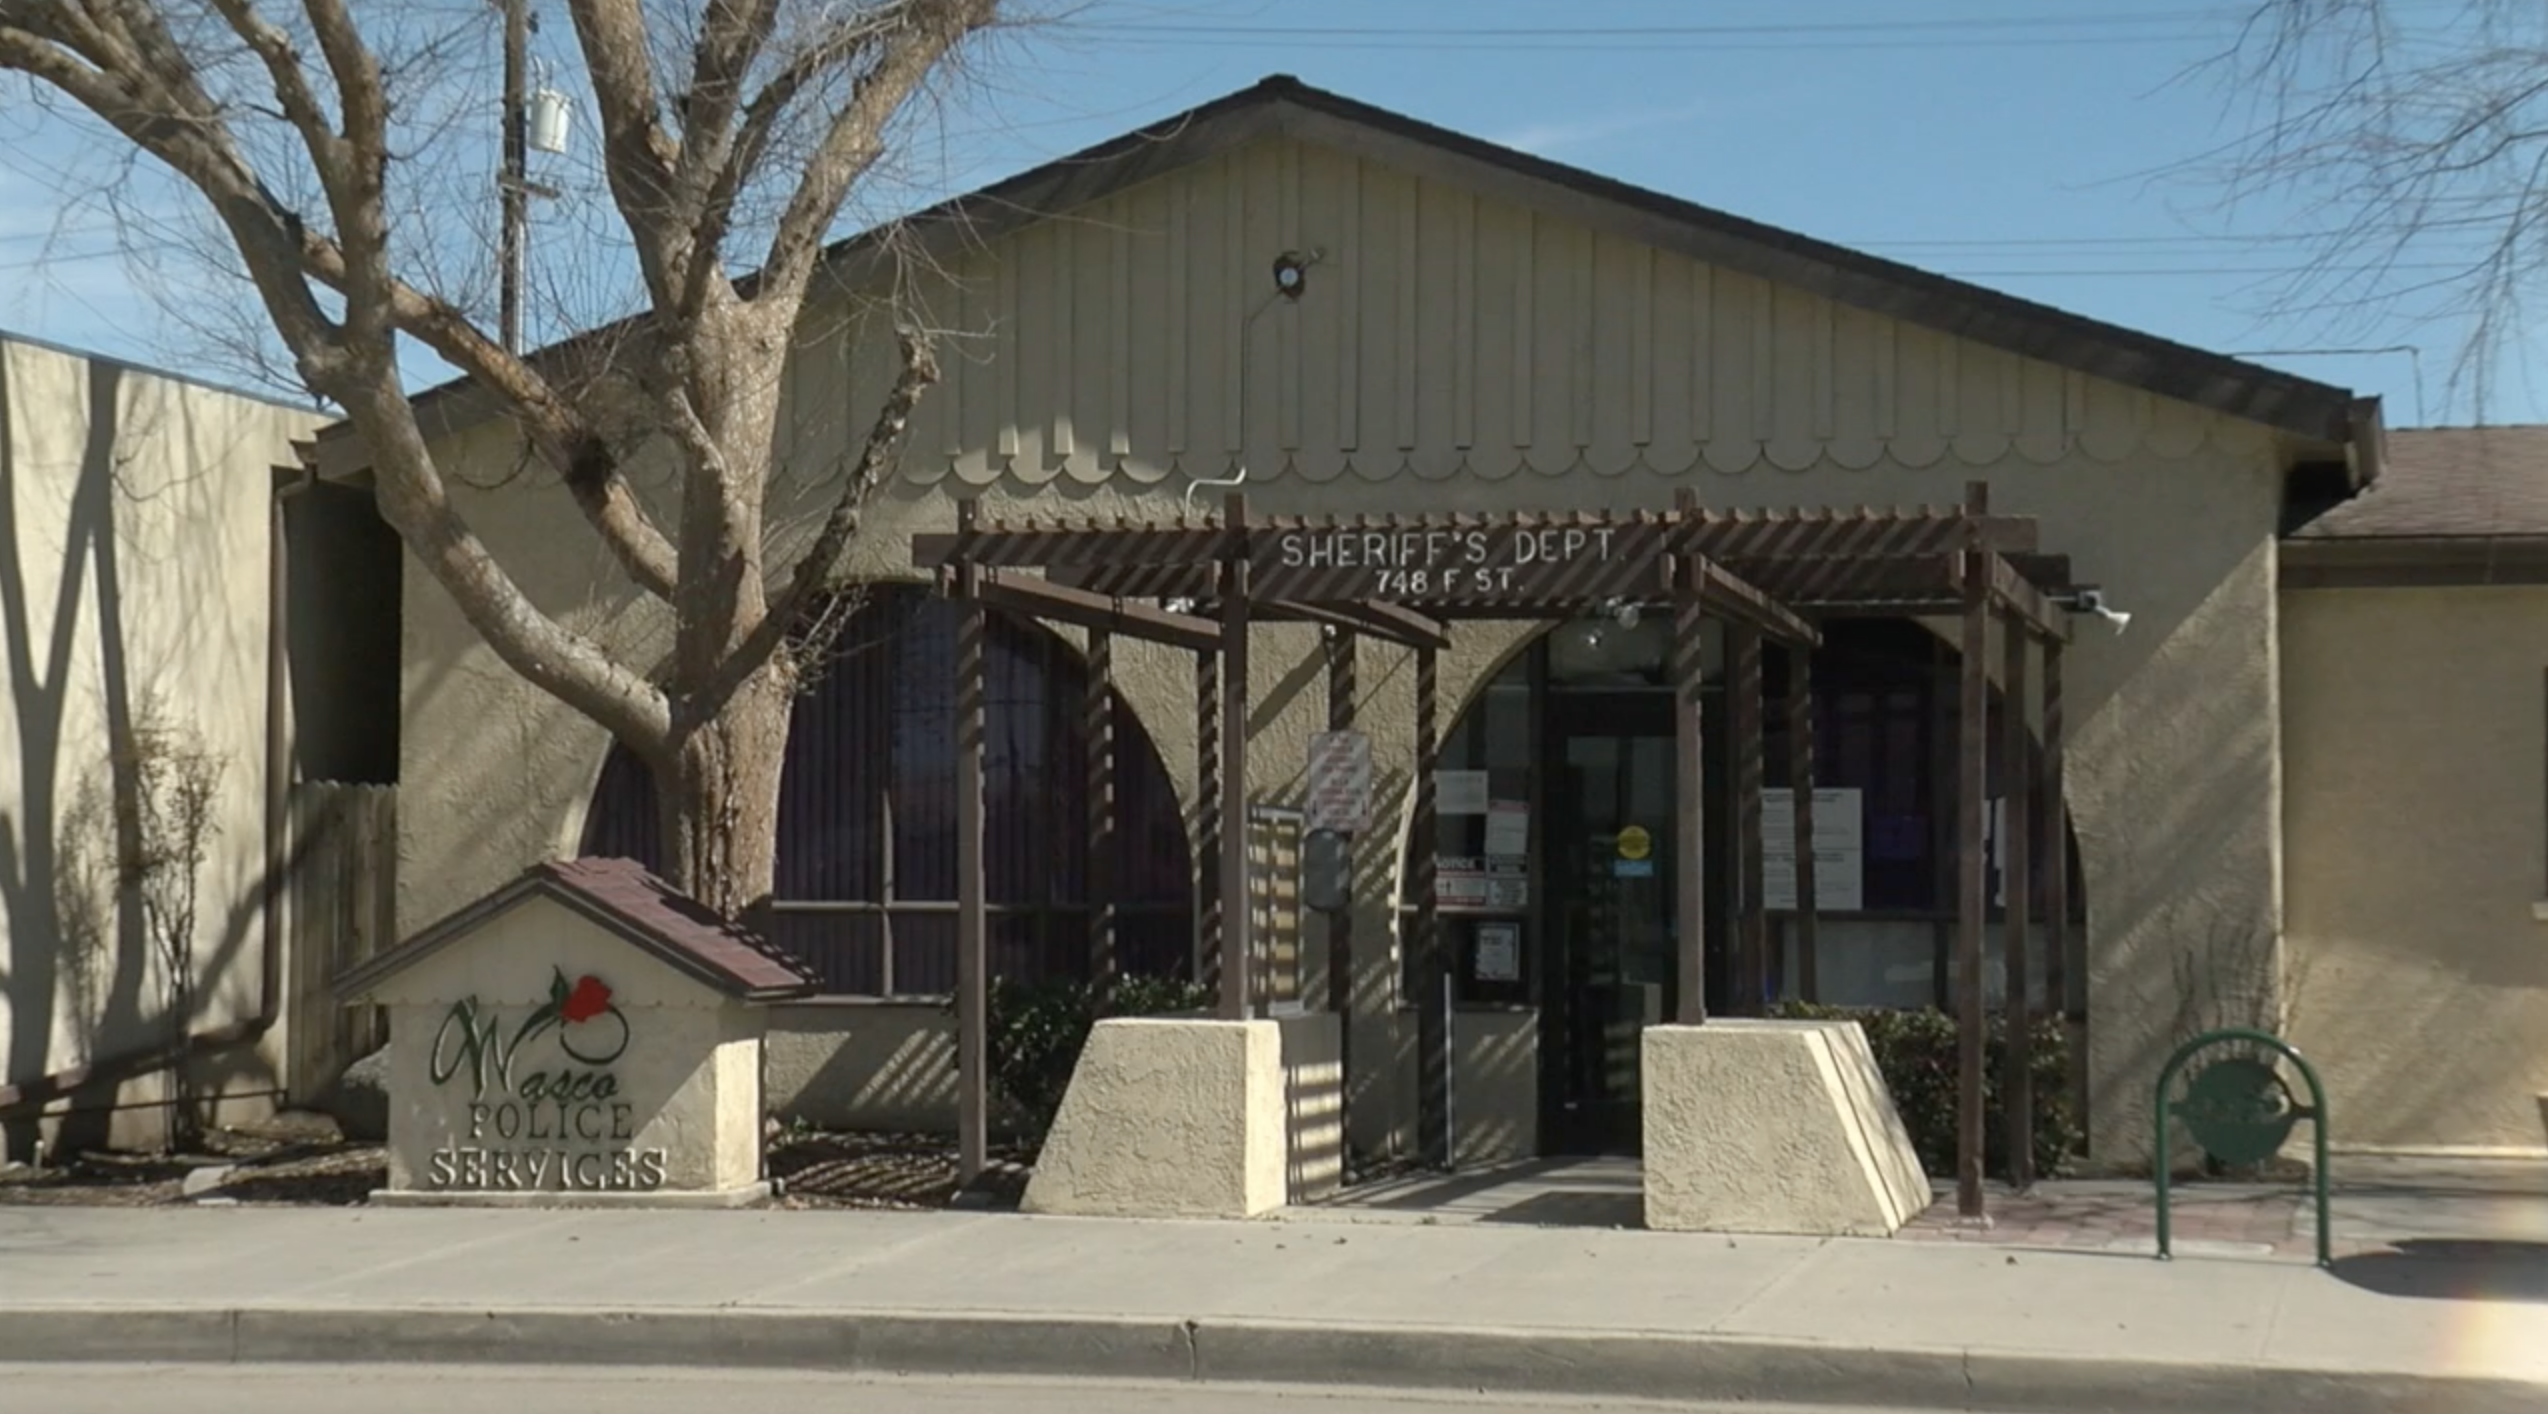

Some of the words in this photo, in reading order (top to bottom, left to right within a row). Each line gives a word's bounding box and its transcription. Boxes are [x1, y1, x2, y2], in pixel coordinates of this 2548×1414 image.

[1281, 532, 1488, 567] SHERIFF'S
[1376, 569, 1428, 594] 748
[1444, 569, 1461, 591] F
[1476, 566, 1526, 592] ST.
[430, 994, 619, 1101] Wasco
[468, 1102, 634, 1140] POLICE
[429, 1147, 668, 1190] SERVICES
